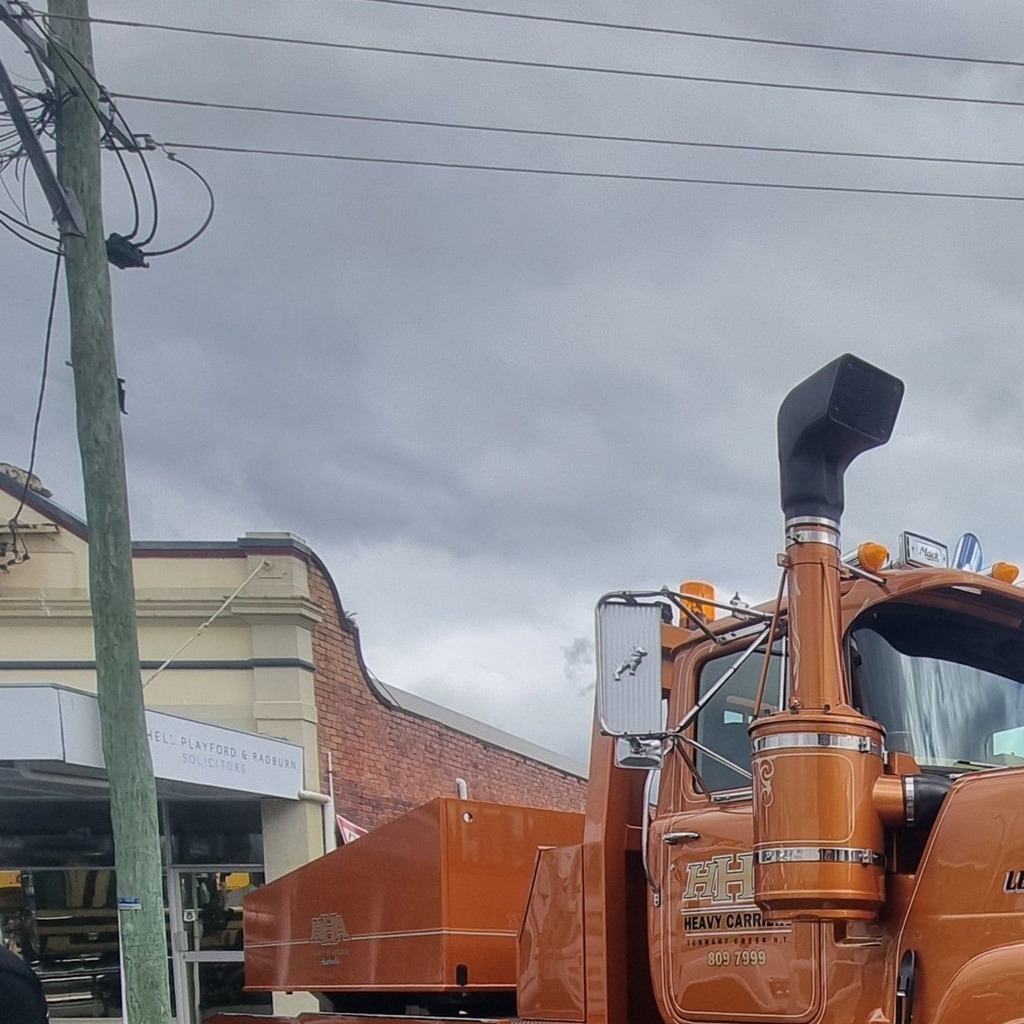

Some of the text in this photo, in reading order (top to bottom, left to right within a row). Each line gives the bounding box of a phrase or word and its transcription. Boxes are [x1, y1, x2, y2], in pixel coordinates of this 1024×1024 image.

[919, 546, 939, 561] Mack
[181, 736, 237, 758] PLAYFORD
[241, 749, 247, 760] &
[253, 752, 296, 770] RADBURN
[182, 753, 246, 774] SOLICITORS
[684, 912, 793, 930] HEAVY CARRI
[707, 949, 767, 966] 809 7999
